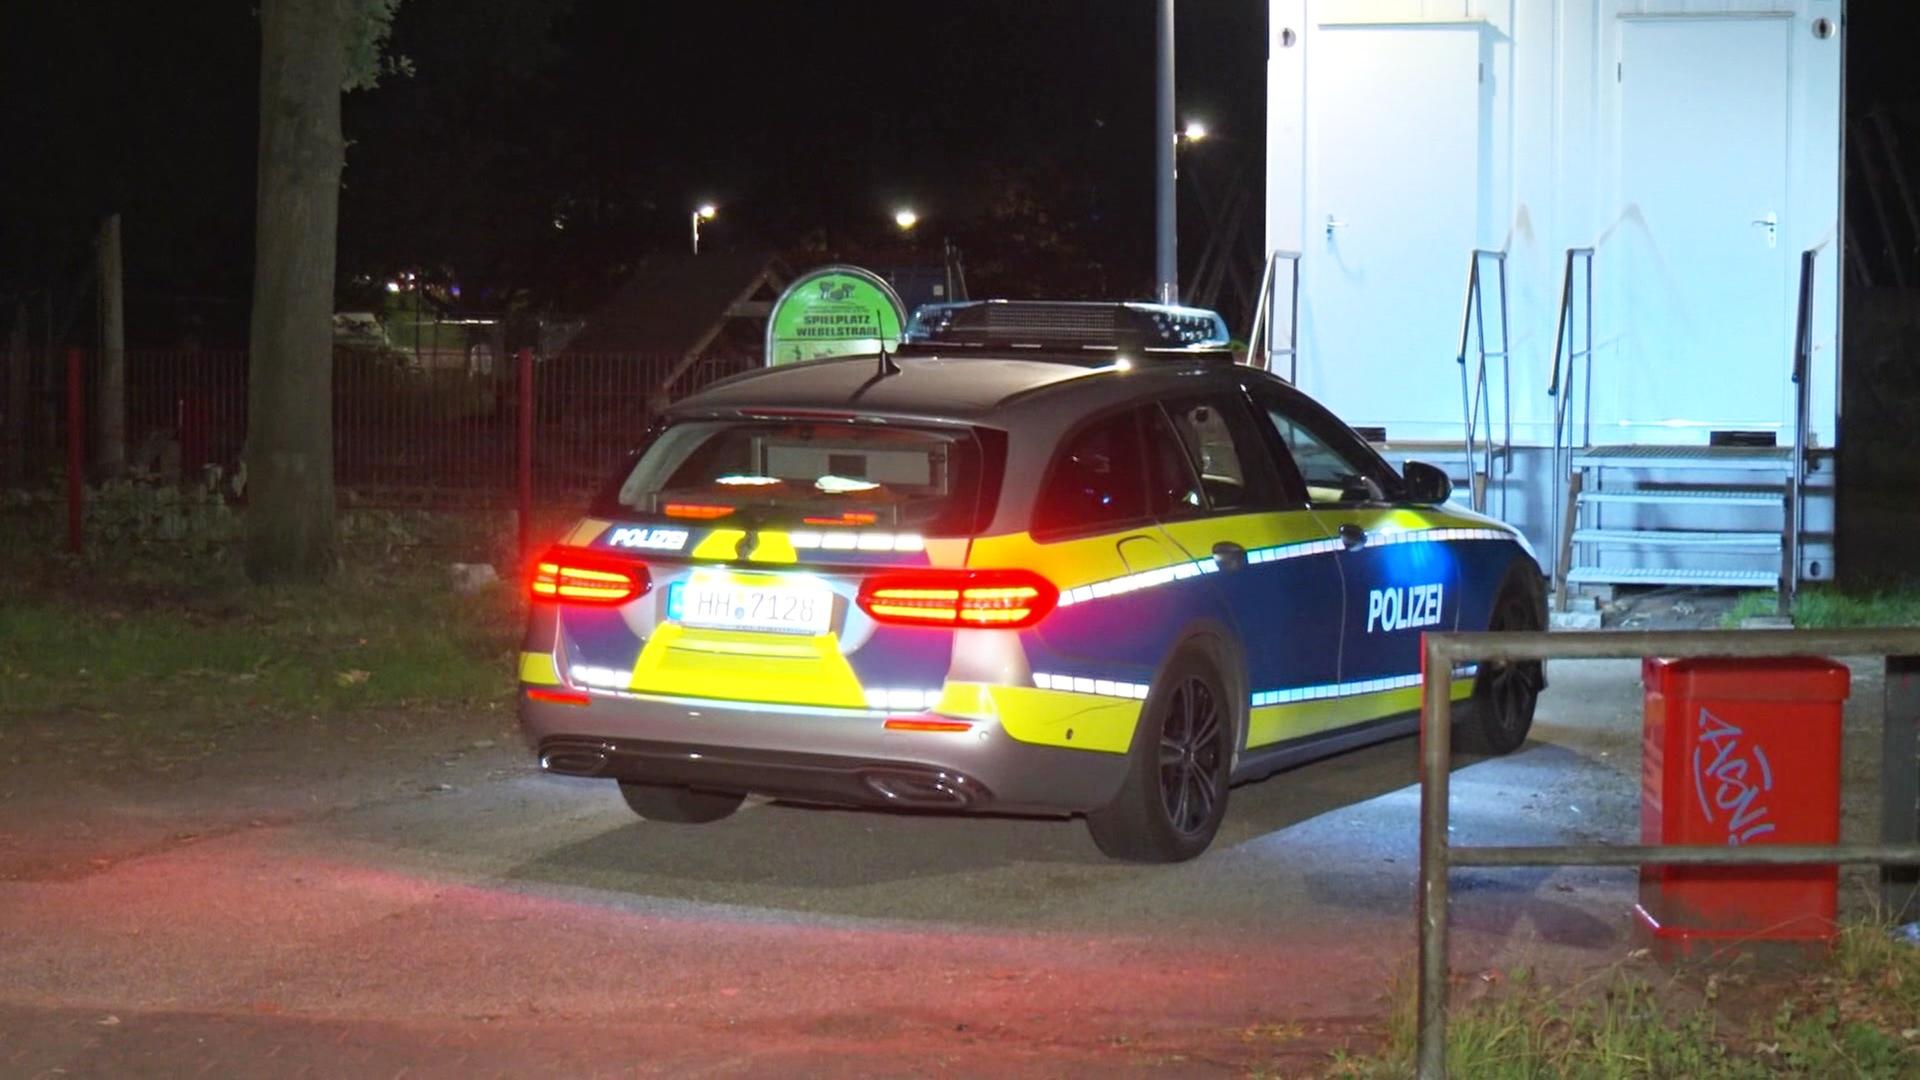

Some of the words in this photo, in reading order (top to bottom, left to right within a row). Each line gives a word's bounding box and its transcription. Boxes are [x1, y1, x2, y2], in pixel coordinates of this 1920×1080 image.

[804, 315, 870, 324] SPIELPLATZ
[609, 527, 688, 550] POLIZEI
[697, 592, 730, 616] HH
[751, 592, 814, 622] 7128
[1367, 583, 1443, 633] POLIZEI
